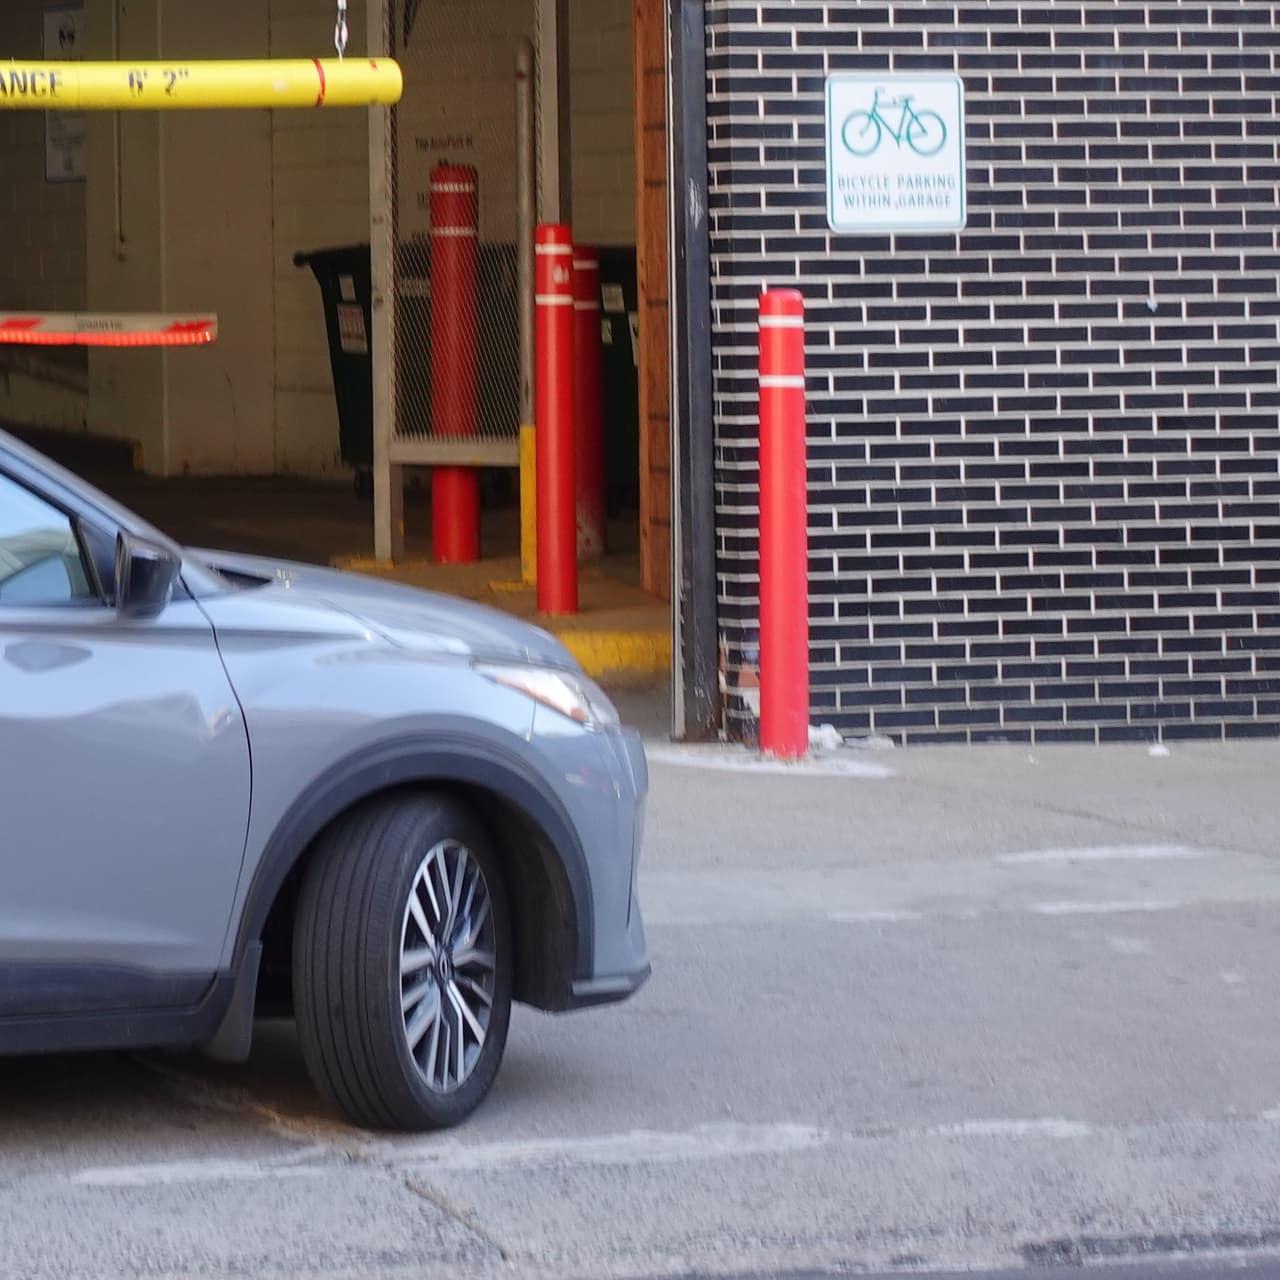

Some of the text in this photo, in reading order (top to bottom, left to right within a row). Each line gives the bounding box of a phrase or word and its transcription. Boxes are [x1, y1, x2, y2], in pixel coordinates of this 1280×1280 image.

[838, 174, 956, 190] BICYCLE PARKING
[843, 193, 951, 208] WITHIN GARAGE
